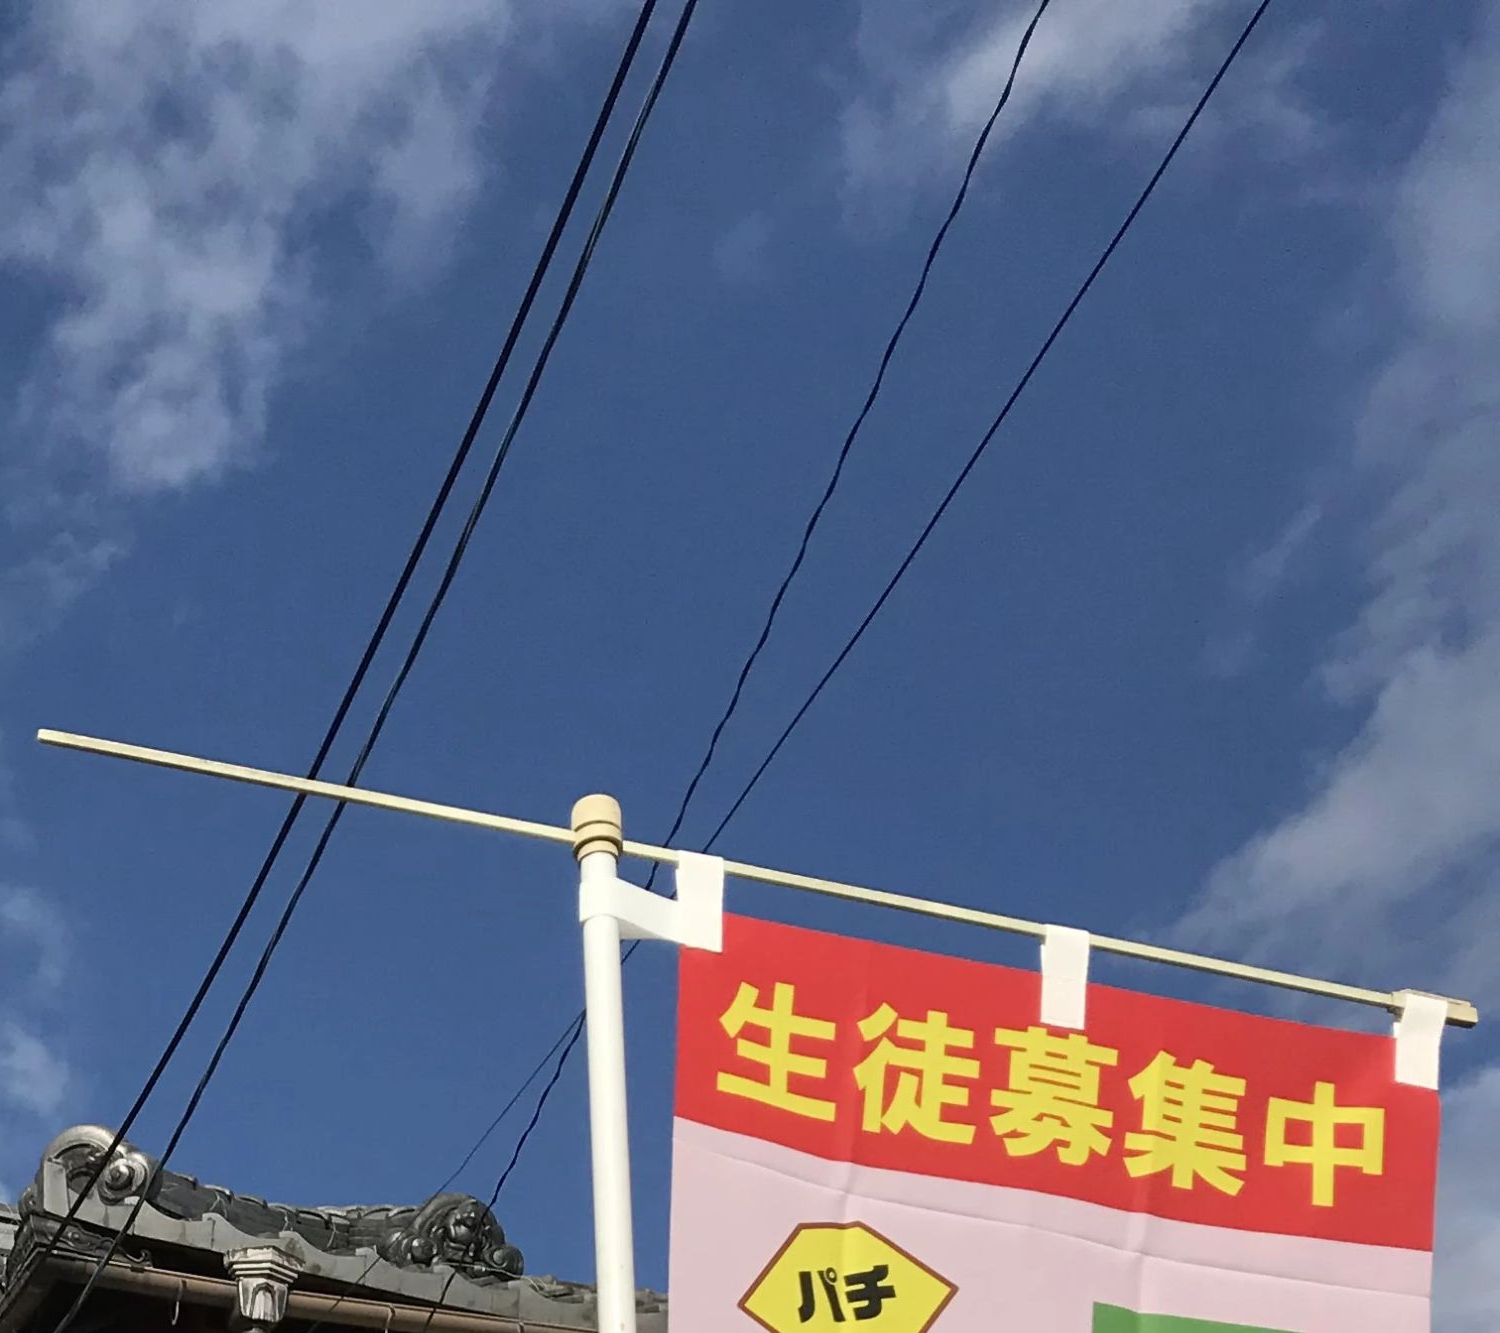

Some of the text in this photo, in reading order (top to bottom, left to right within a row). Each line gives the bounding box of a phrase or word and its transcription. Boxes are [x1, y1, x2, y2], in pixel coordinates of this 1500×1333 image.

[716, 982, 1386, 1207] 生徒募集中
[797, 1264, 896, 1324] パチ
